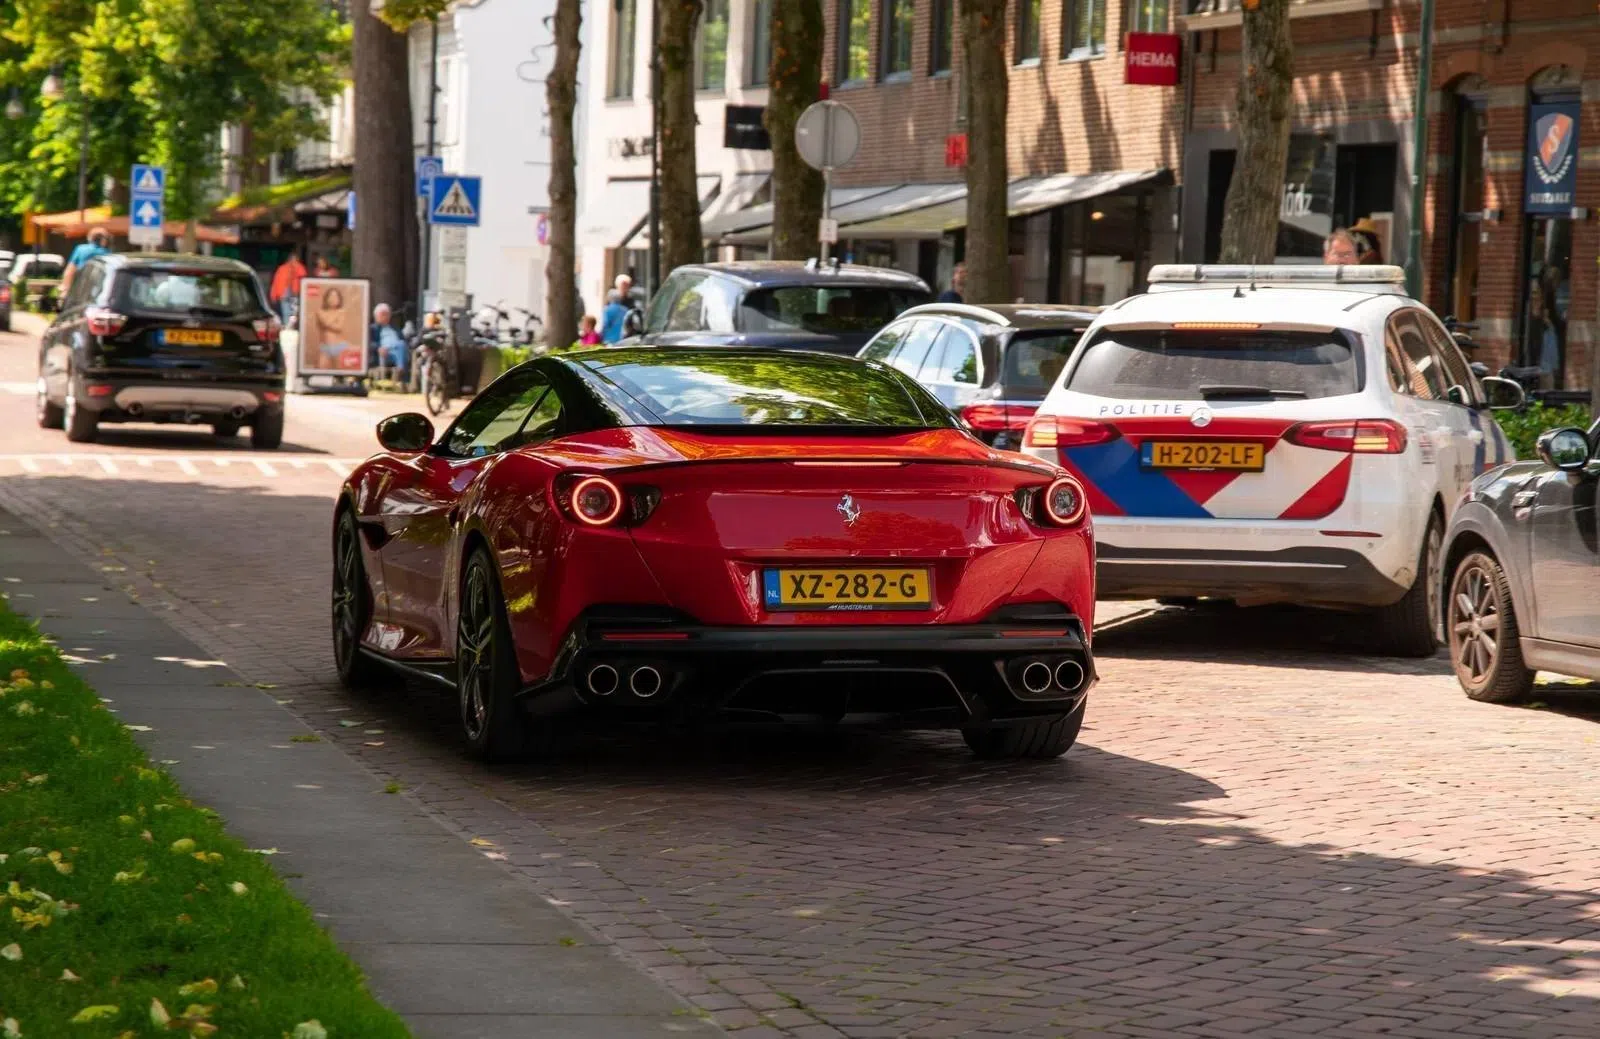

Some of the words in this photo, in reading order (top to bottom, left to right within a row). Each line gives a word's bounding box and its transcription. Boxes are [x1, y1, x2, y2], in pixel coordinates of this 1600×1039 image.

[1129, 51, 1176, 67] HEMA
[1099, 404, 1184, 416] POLITIE
[1159, 445, 1257, 464] H-202-LF
[767, 590, 780, 599] NL
[790, 574, 917, 599] XZ-282-G
